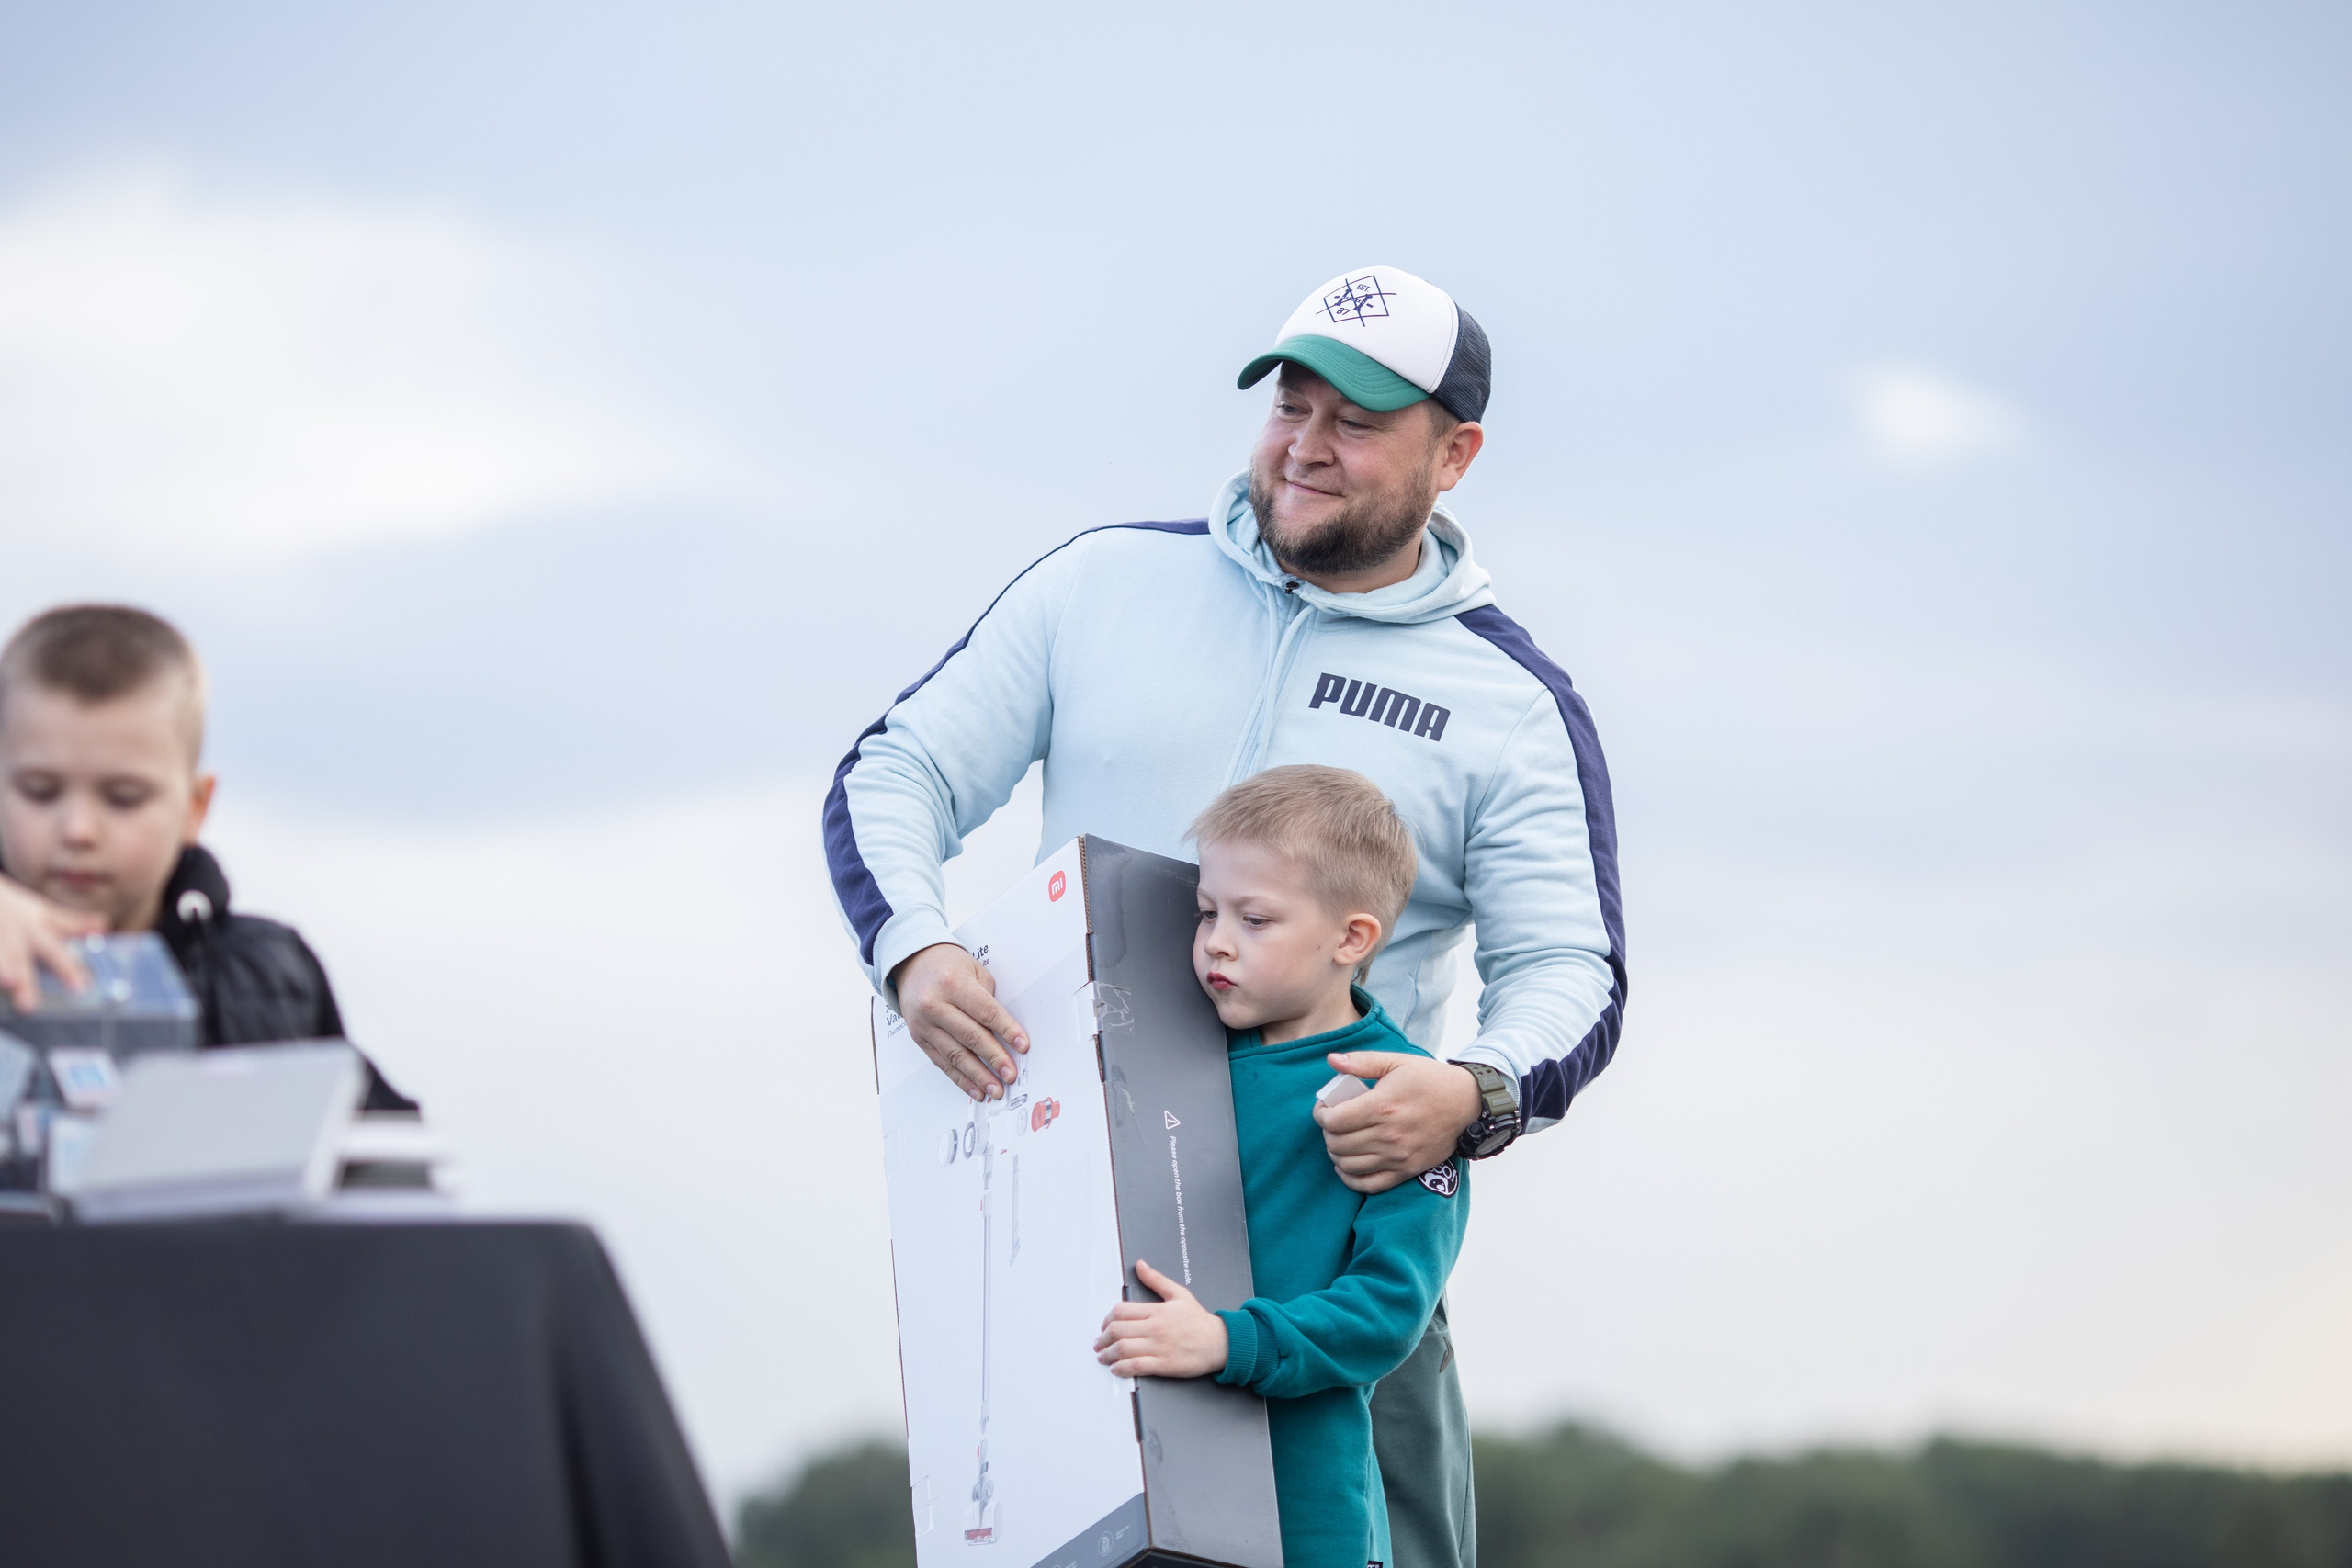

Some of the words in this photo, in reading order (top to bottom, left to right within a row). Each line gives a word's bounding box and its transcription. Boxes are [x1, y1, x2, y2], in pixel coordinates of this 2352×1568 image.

[1308, 672, 1451, 742] PUMA
[1171, 1159, 1180, 1179] open
[1180, 1236, 1190, 1269] opposite
